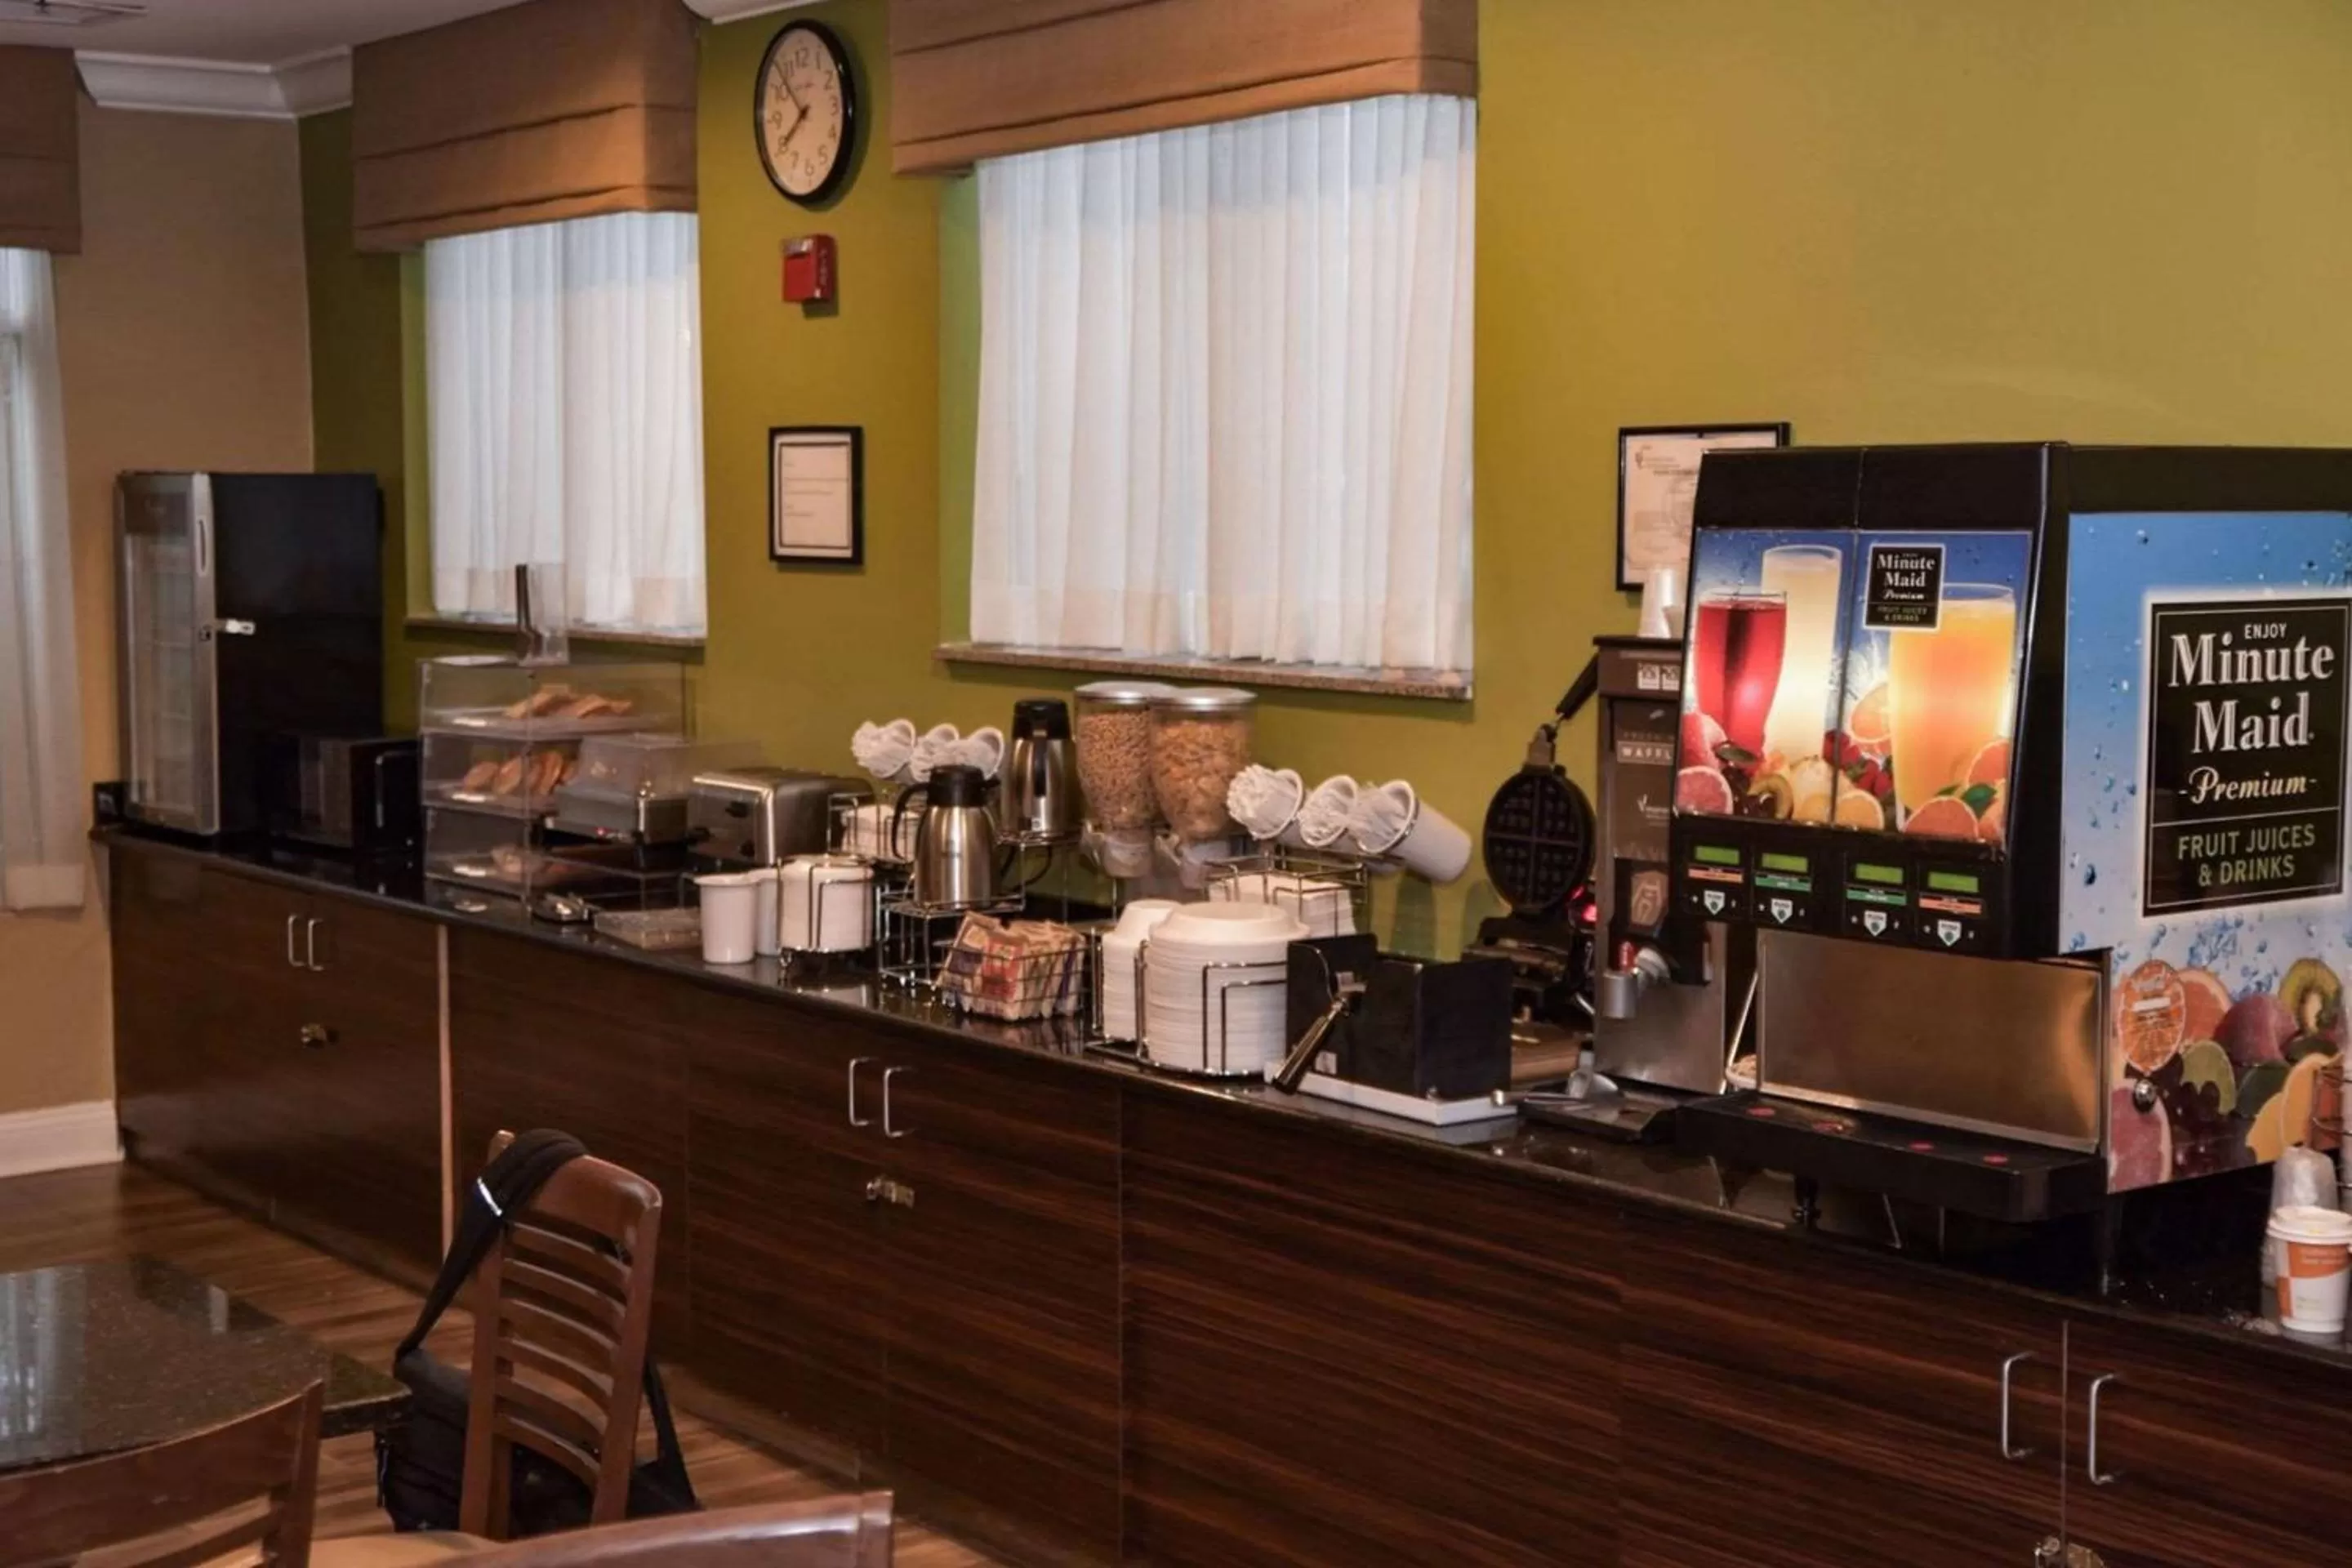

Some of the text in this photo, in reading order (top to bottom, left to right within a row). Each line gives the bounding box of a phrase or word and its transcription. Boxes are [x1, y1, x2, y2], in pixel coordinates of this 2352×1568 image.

[795, 47, 809, 68] 12
[783, 60, 795, 77] 11
[823, 70, 833, 89] 2
[831, 96, 838, 115] 3
[772, 110, 782, 129] 9
[828, 123, 836, 142] 4
[790, 150, 799, 168] 7
[818, 145, 828, 165] 5
[804, 158, 814, 176] 6
[1877, 554, 1936, 570] Minute
[1884, 571, 1926, 587] Maid
[2244, 623, 2287, 639] ENJOY
[2167, 631, 2335, 688] Minute
[2191, 691, 2310, 754] Maid
[2177, 823, 2315, 860] FRUIT JUICES
[2198, 854, 2296, 887] & DRINKS
